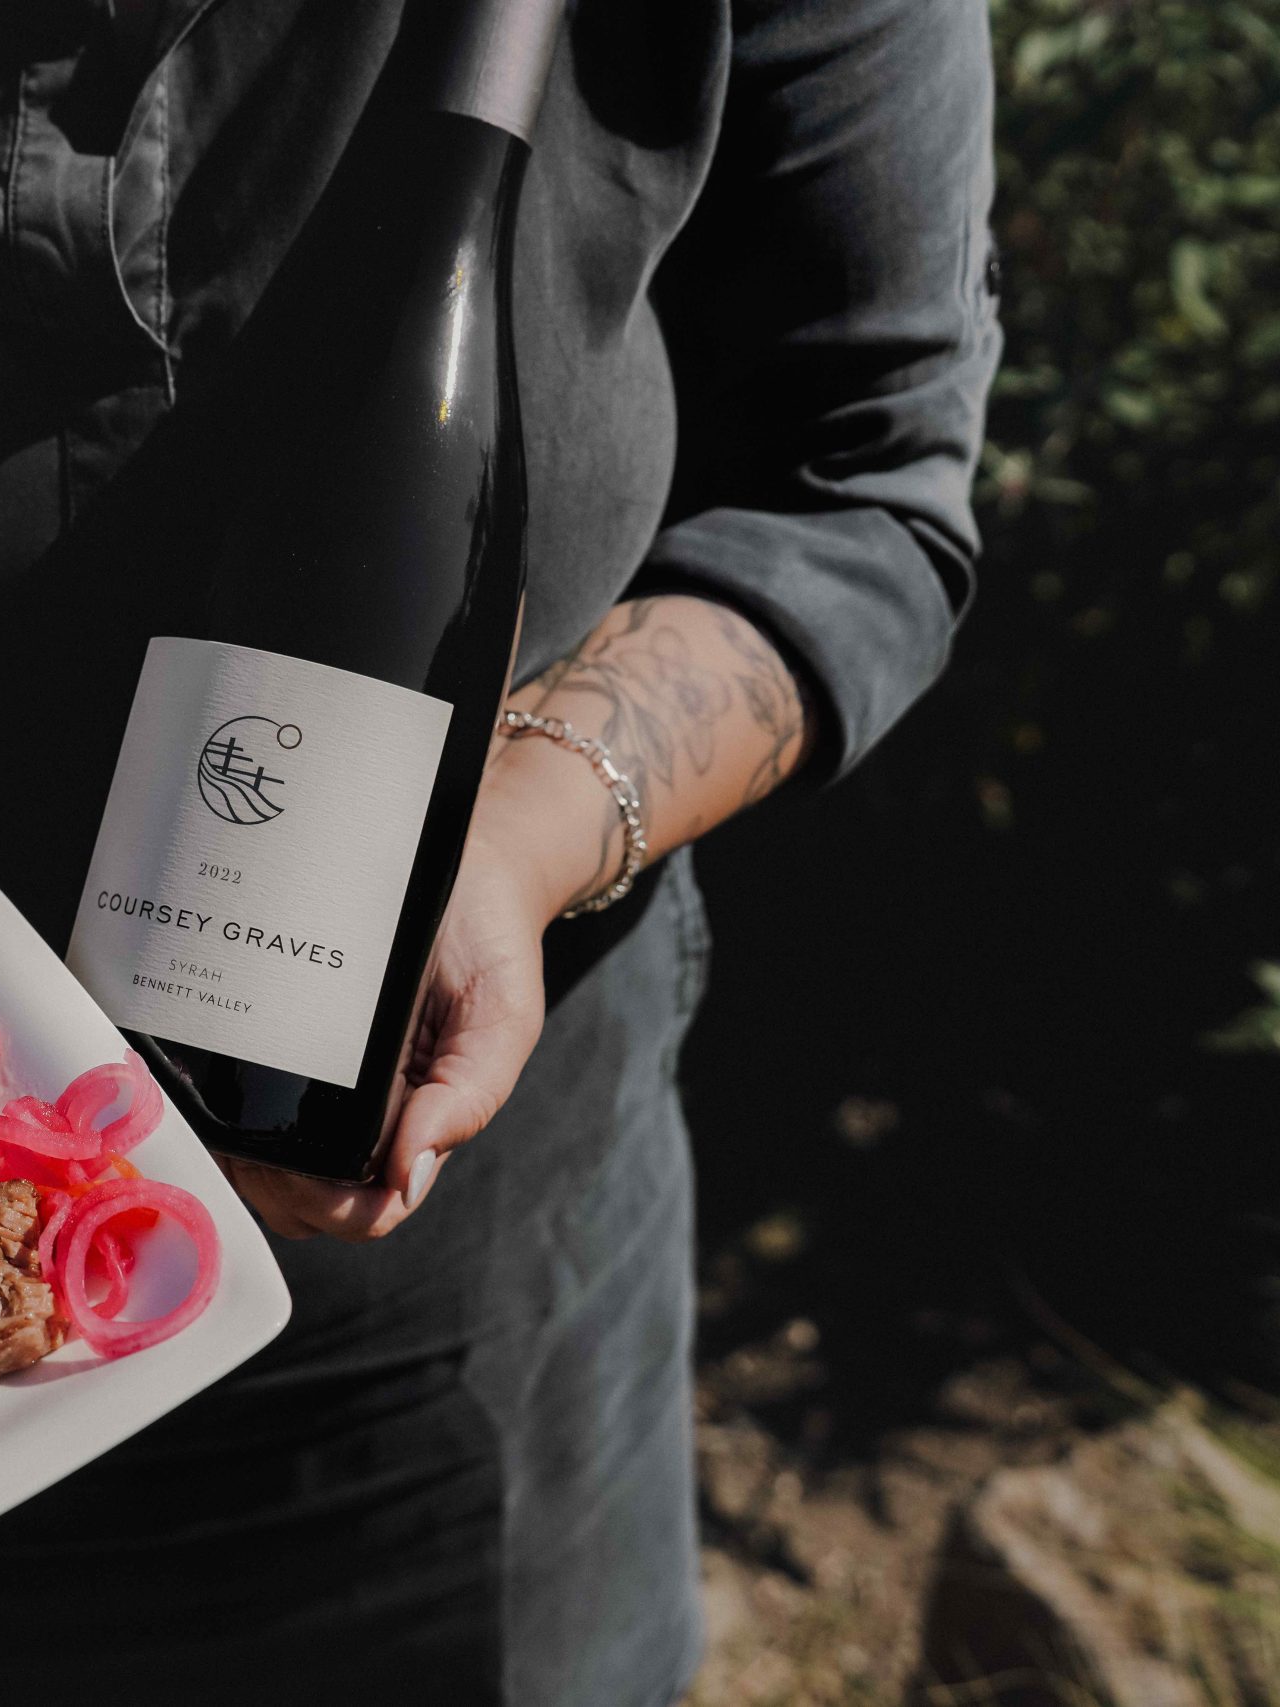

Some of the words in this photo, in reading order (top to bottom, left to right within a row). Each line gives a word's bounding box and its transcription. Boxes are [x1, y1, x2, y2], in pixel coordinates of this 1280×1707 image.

[197, 862, 242, 885] 2022
[97, 890, 212, 933] COURSEY
[222, 922, 344, 969] GRAVES
[168, 958, 223, 983] SYRAH
[132, 974, 193, 999] BENNETT
[198, 990, 252, 1014] VALLEY
